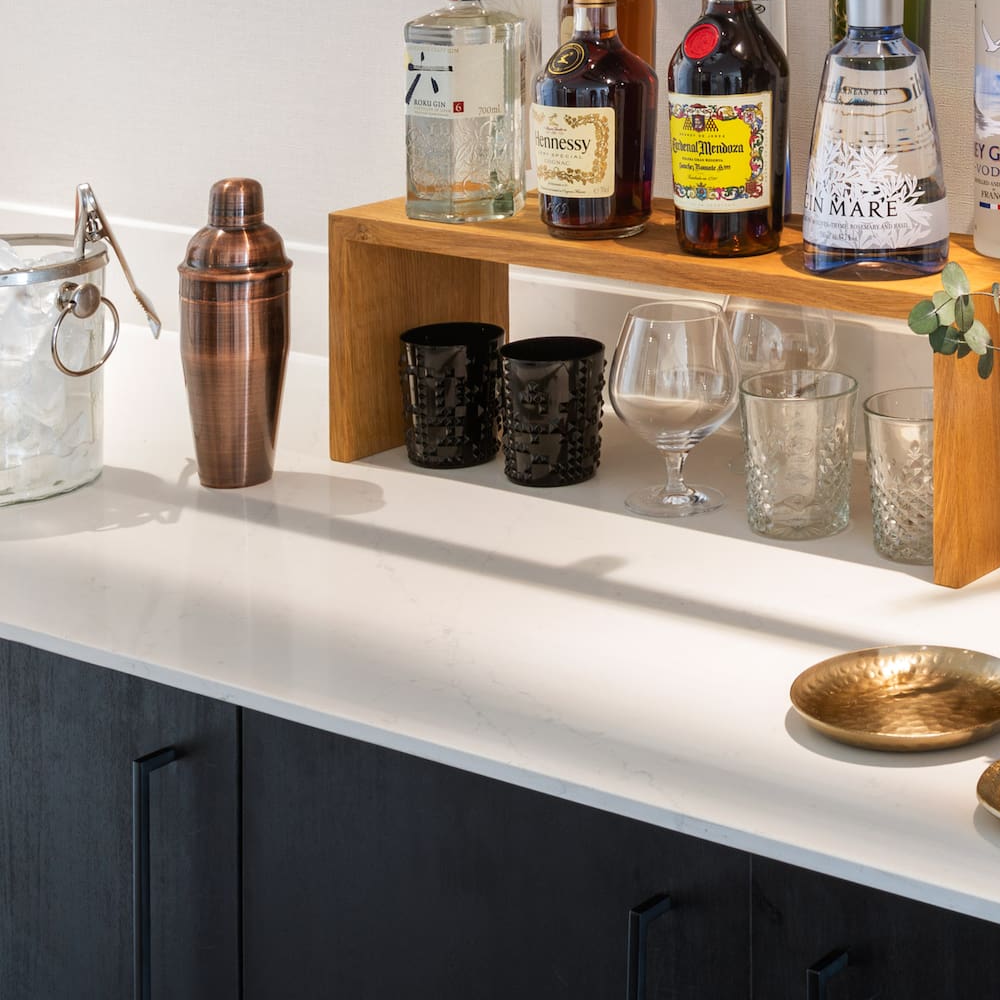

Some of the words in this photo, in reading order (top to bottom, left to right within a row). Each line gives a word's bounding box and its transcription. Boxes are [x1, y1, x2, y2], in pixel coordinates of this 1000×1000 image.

[455, 103, 462, 112] 6
[535, 130, 591, 154] Hennessy
[698, 140, 744, 157] Mendoza
[974, 142, 986, 159] EY
[551, 152, 584, 160] SPECIAL
[829, 200, 898, 219] MARE
[850, 222, 880, 231] ROSEMARY
[881, 222, 893, 230] AND
